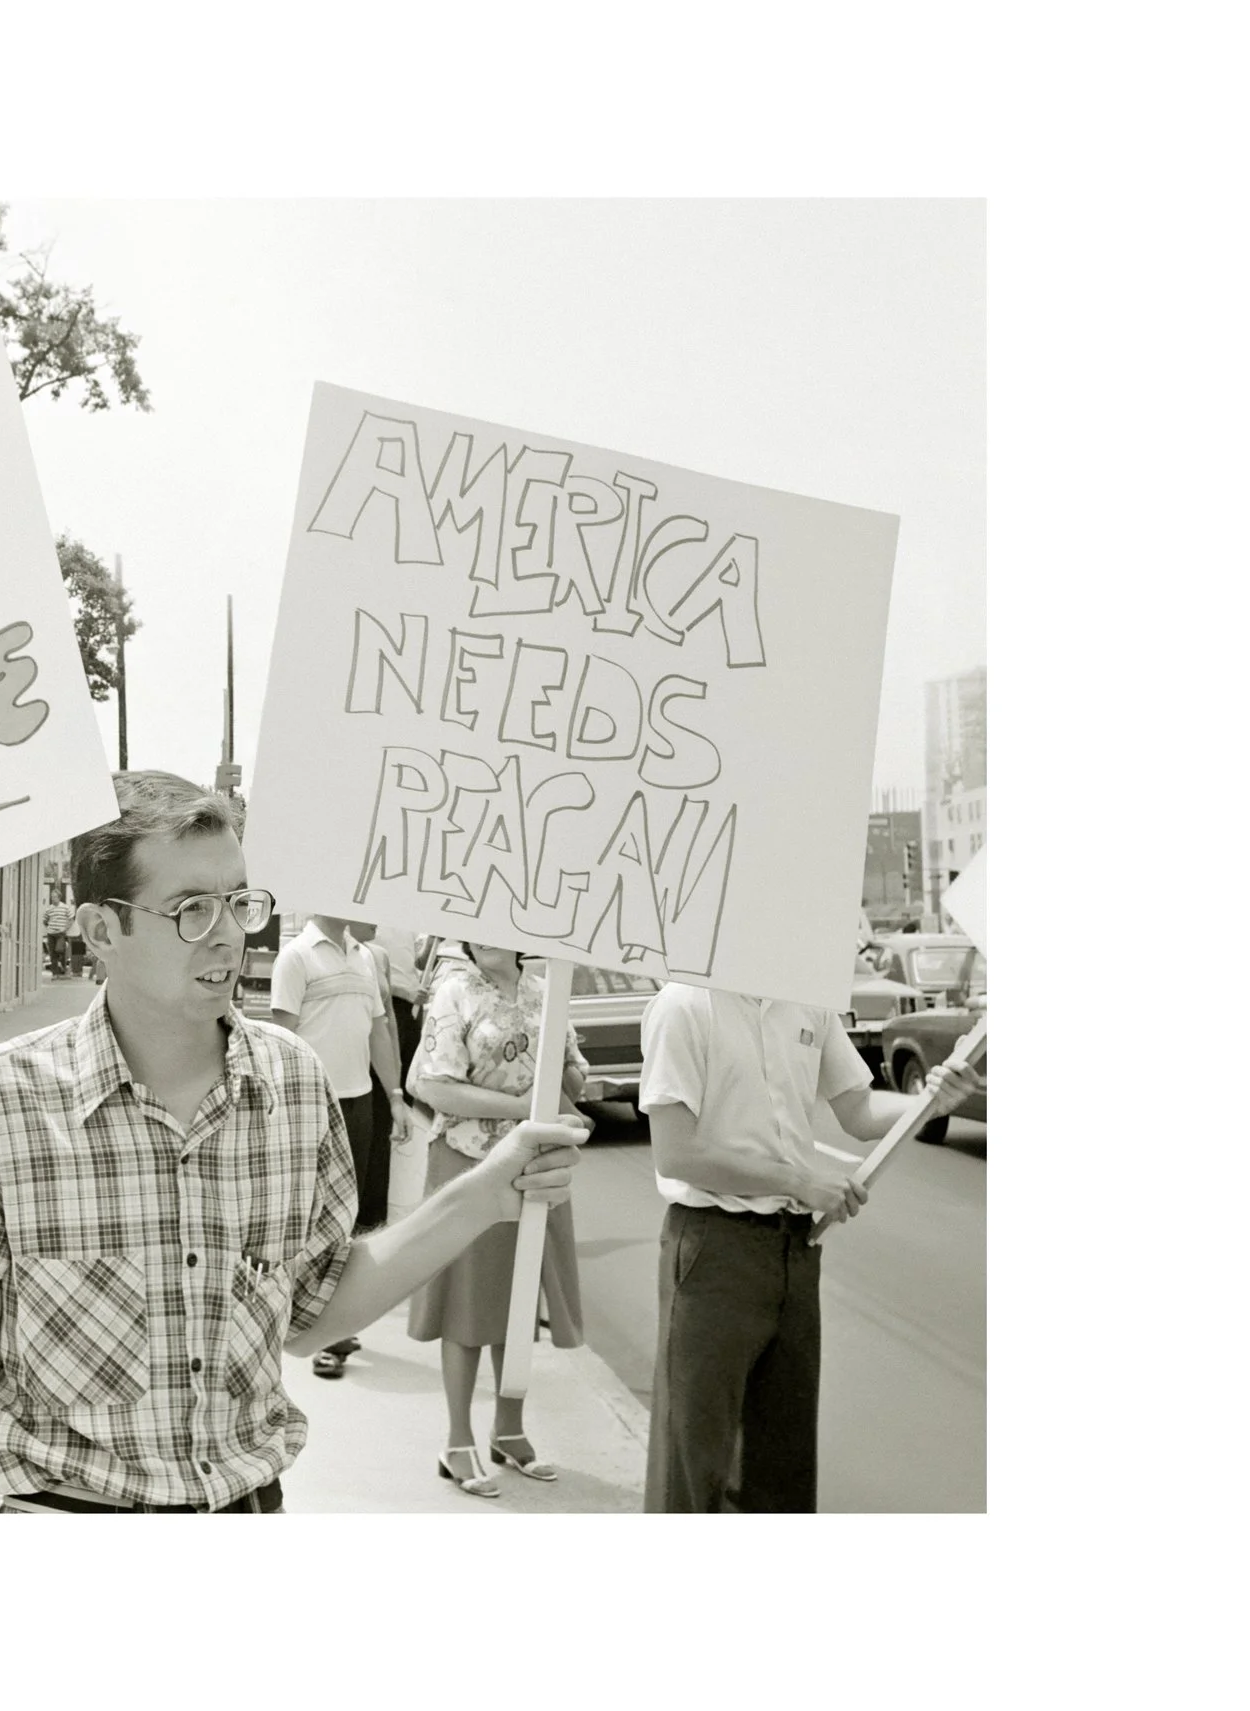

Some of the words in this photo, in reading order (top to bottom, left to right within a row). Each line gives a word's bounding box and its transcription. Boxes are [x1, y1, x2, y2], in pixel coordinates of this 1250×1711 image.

[307, 411, 766, 668] AMERICA
[345, 608, 722, 789] NEEDS
[353, 746, 737, 977] REAGAN
